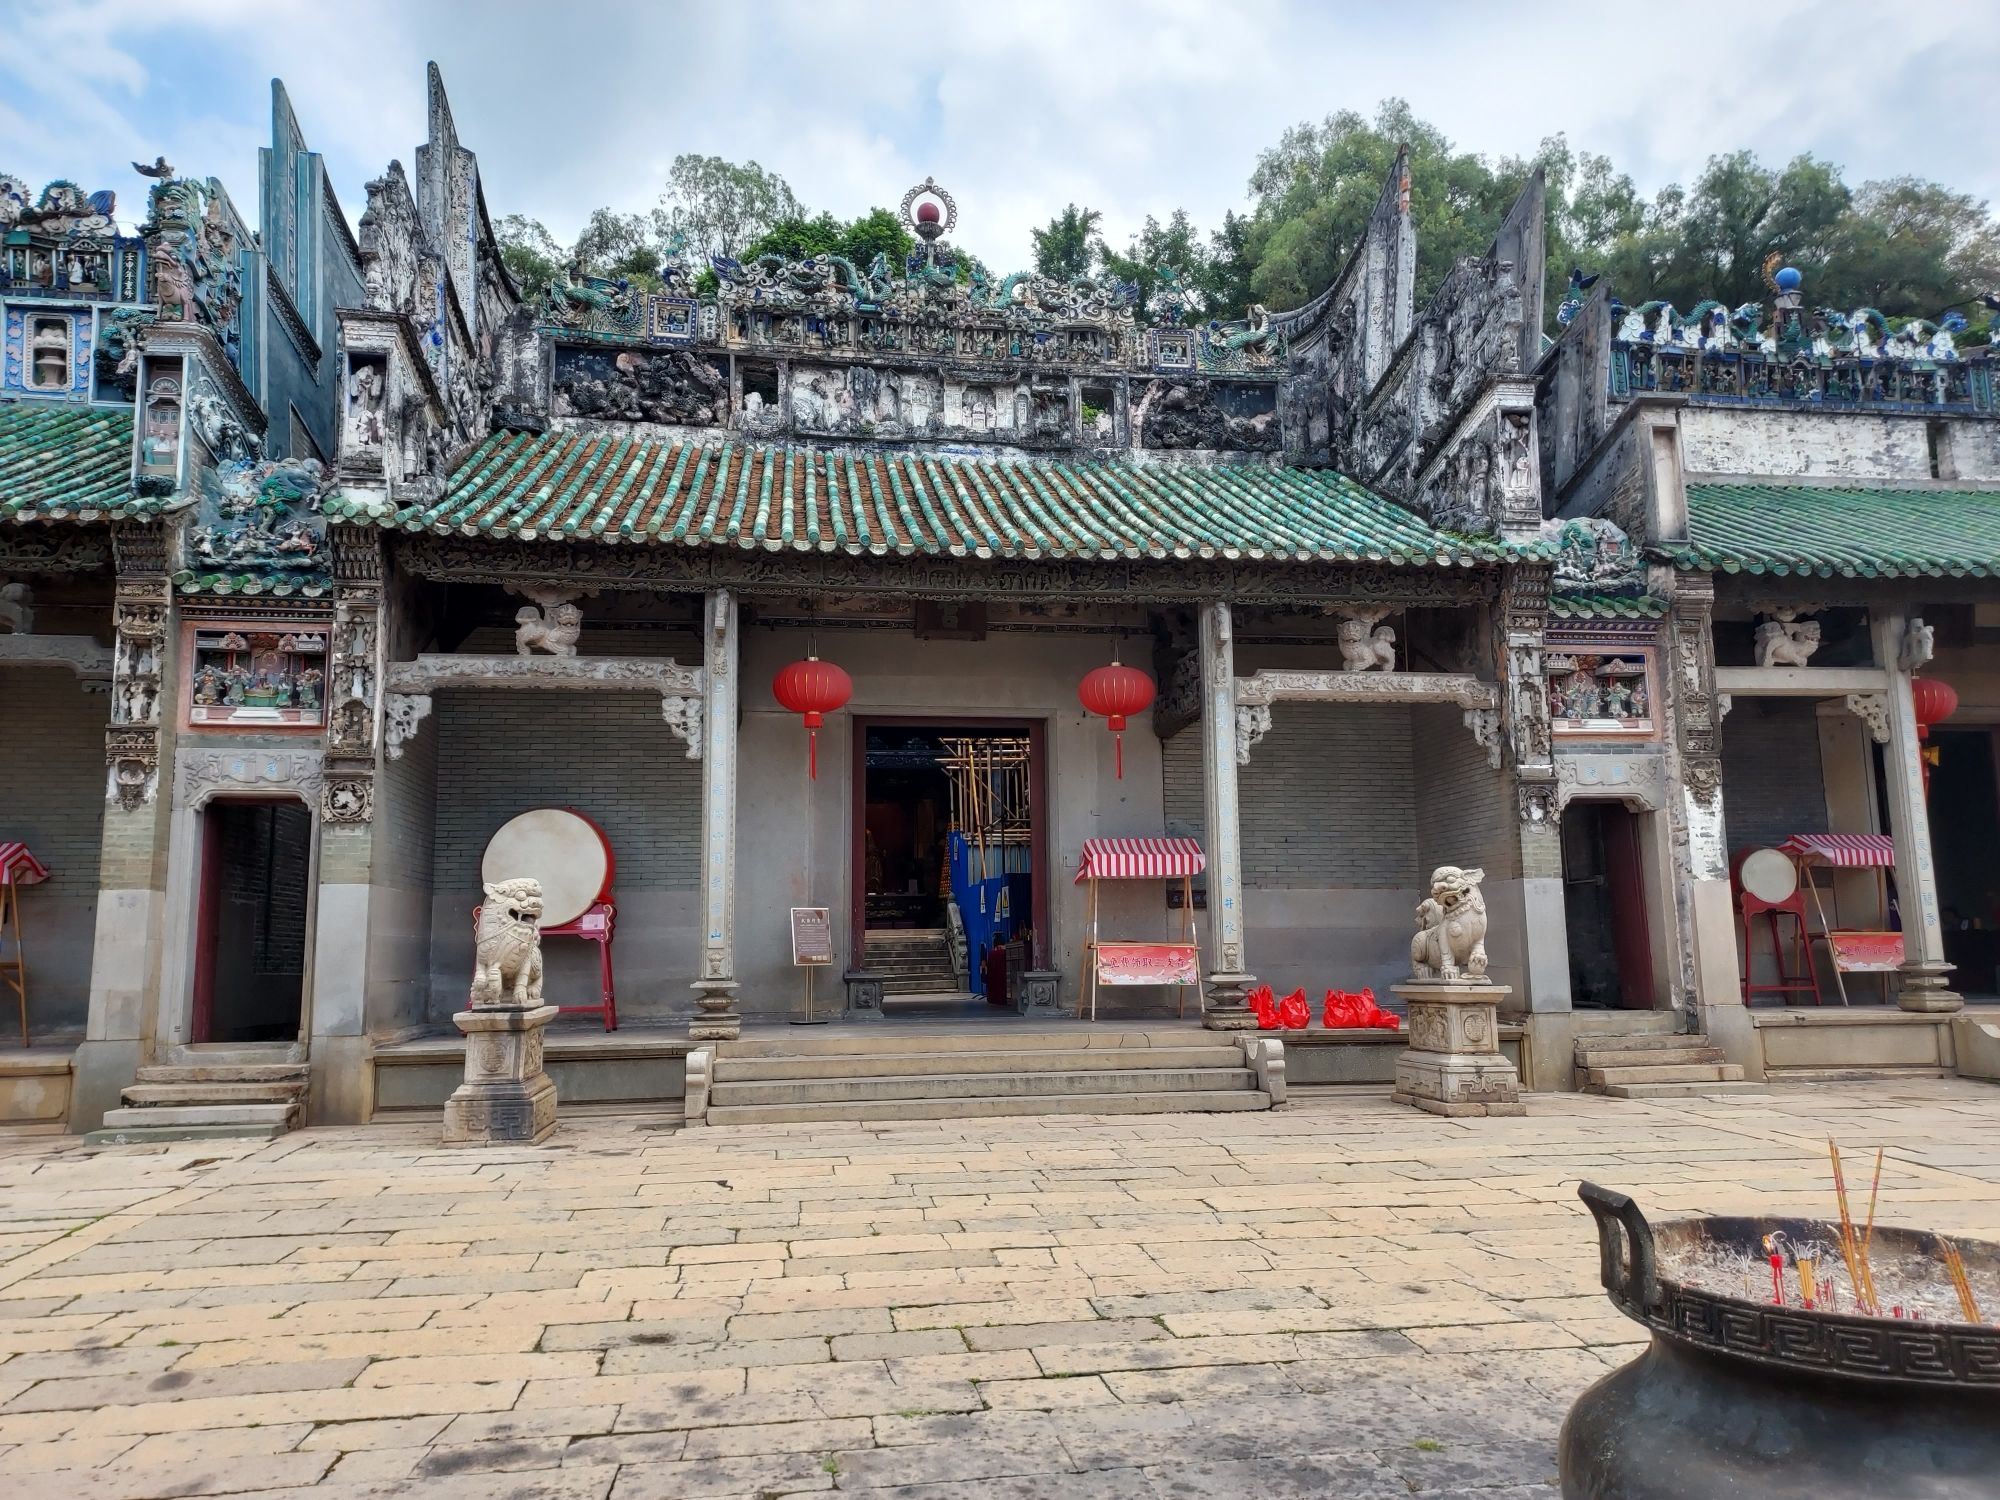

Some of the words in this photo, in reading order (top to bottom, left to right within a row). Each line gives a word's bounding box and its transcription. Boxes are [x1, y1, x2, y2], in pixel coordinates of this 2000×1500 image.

[1109, 956, 1186, 969] 免费领取三支香
